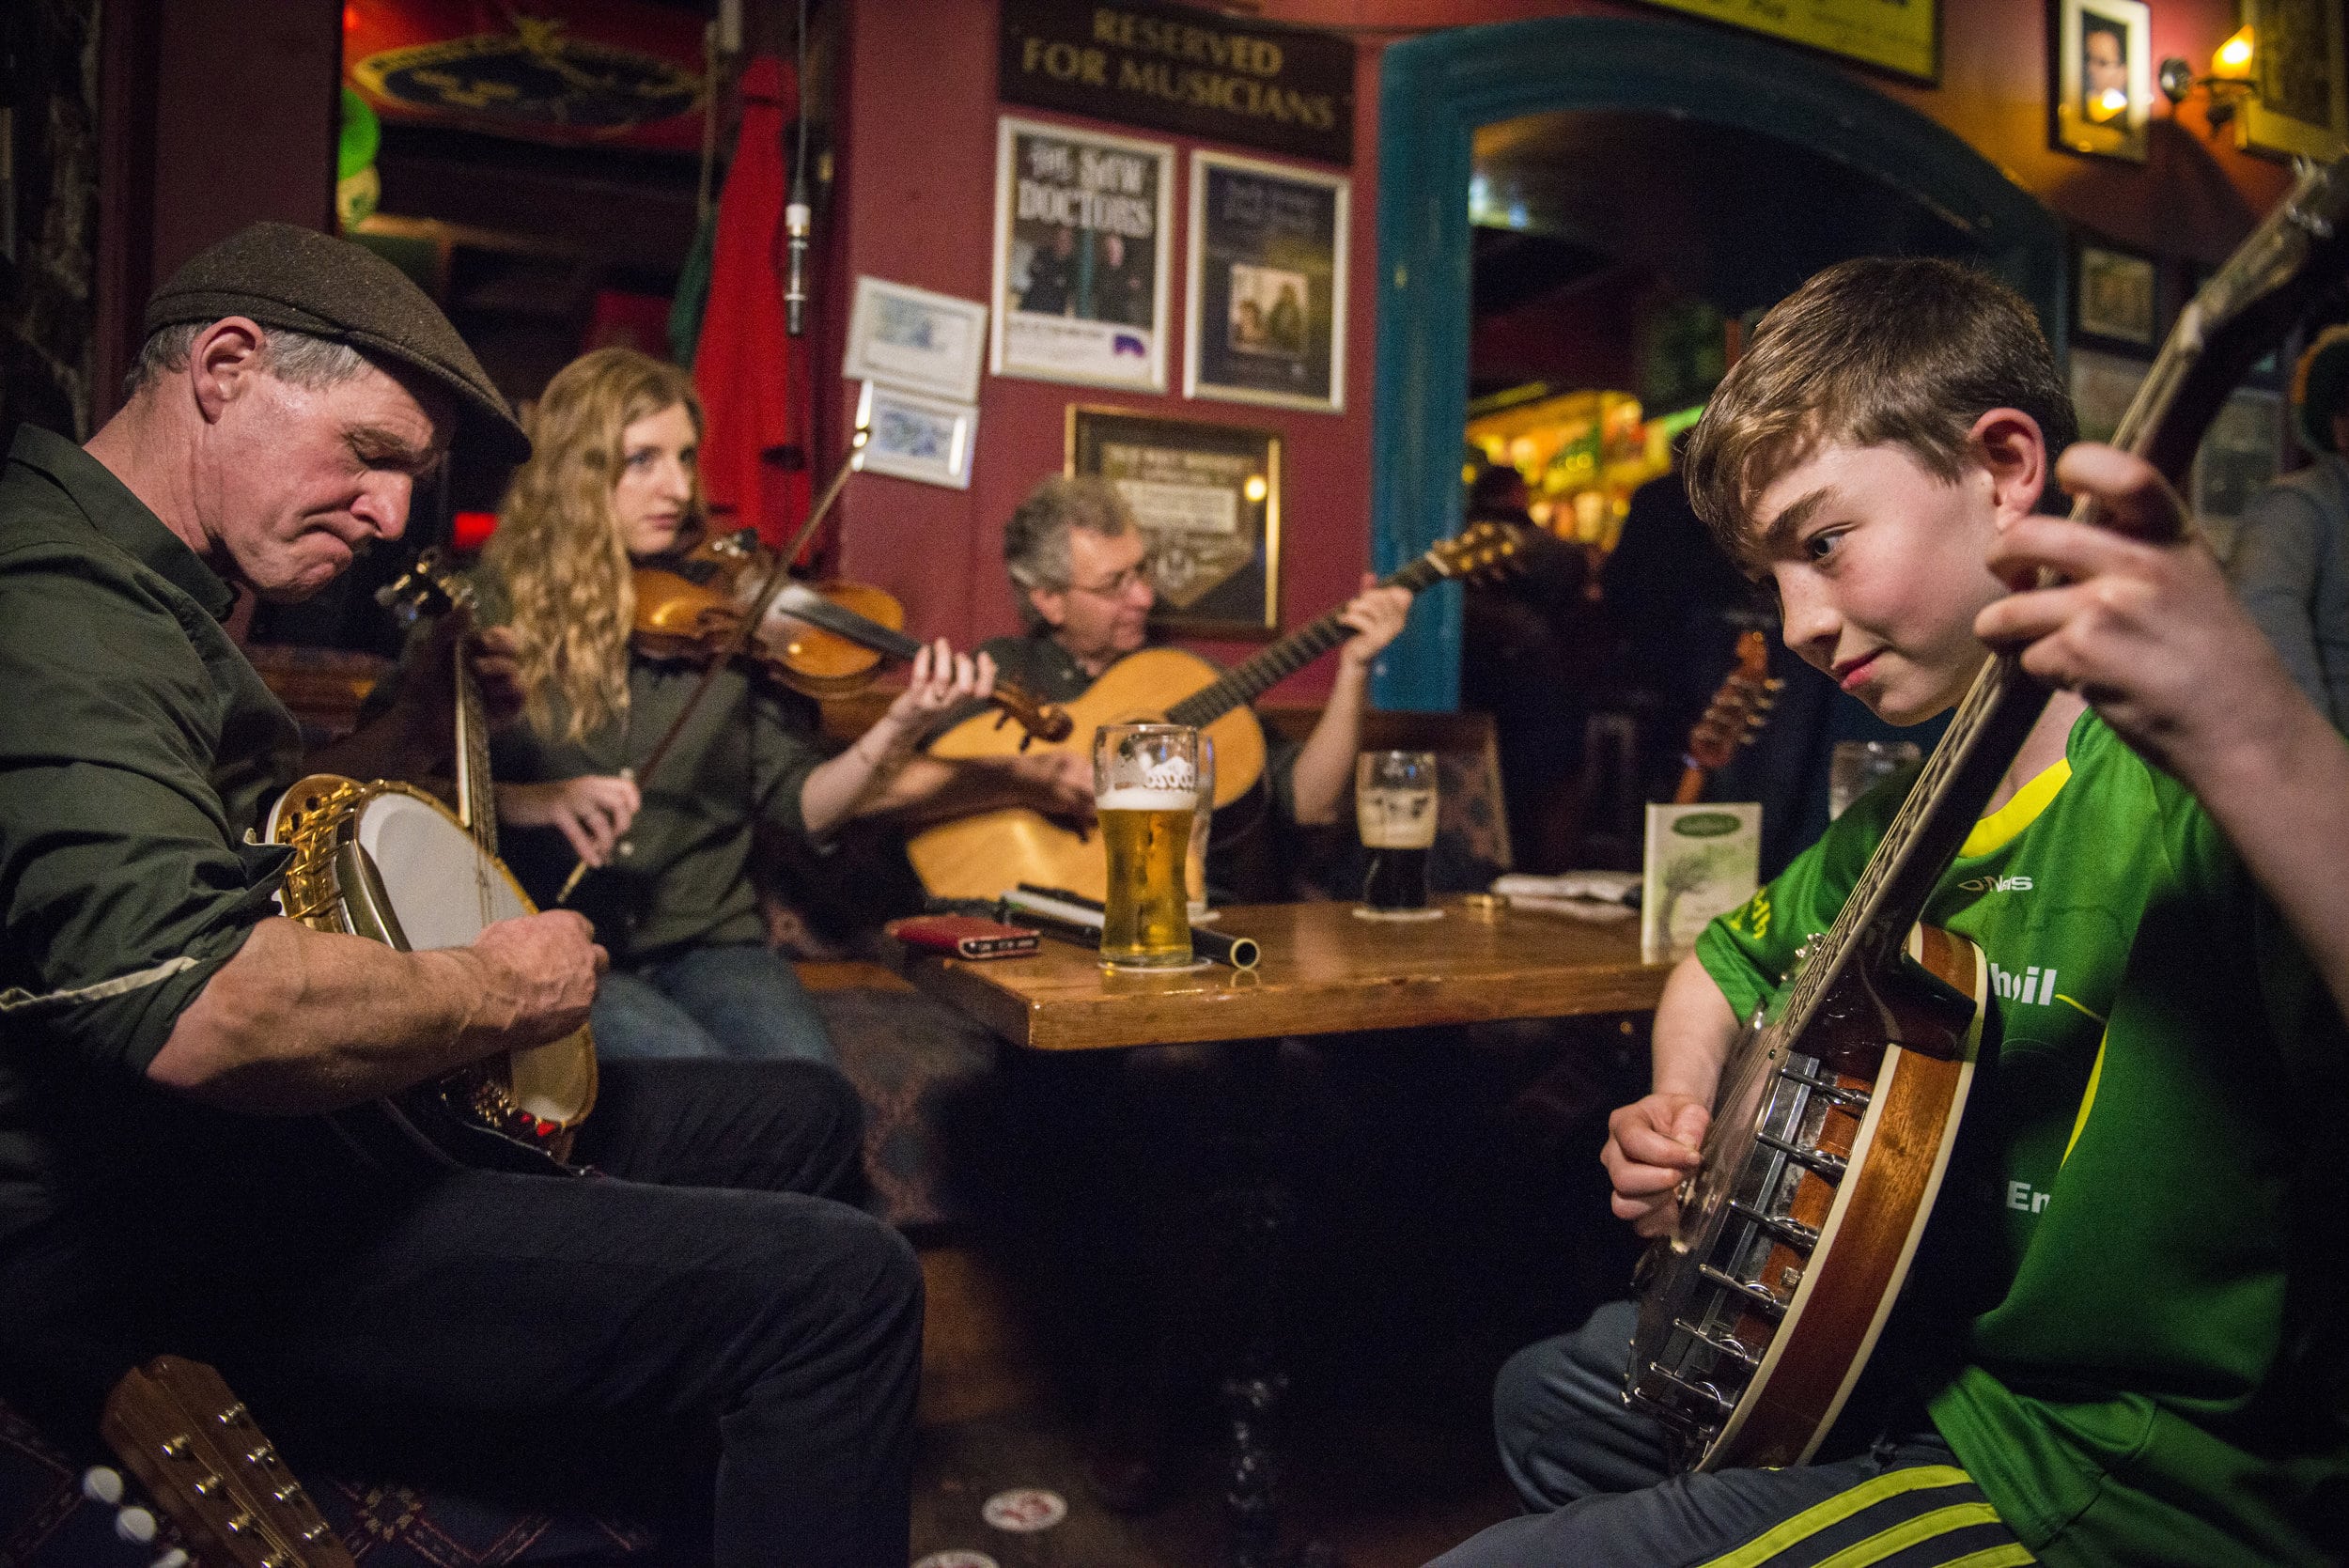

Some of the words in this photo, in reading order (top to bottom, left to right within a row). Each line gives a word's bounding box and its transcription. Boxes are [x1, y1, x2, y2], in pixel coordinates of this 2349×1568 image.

[1093, 8, 1284, 77] RESERVED
[1022, 38, 1108, 85] FOR
[1119, 59, 1335, 130] MUSICIANS
[1018, 179, 1153, 239] DOCTORS
